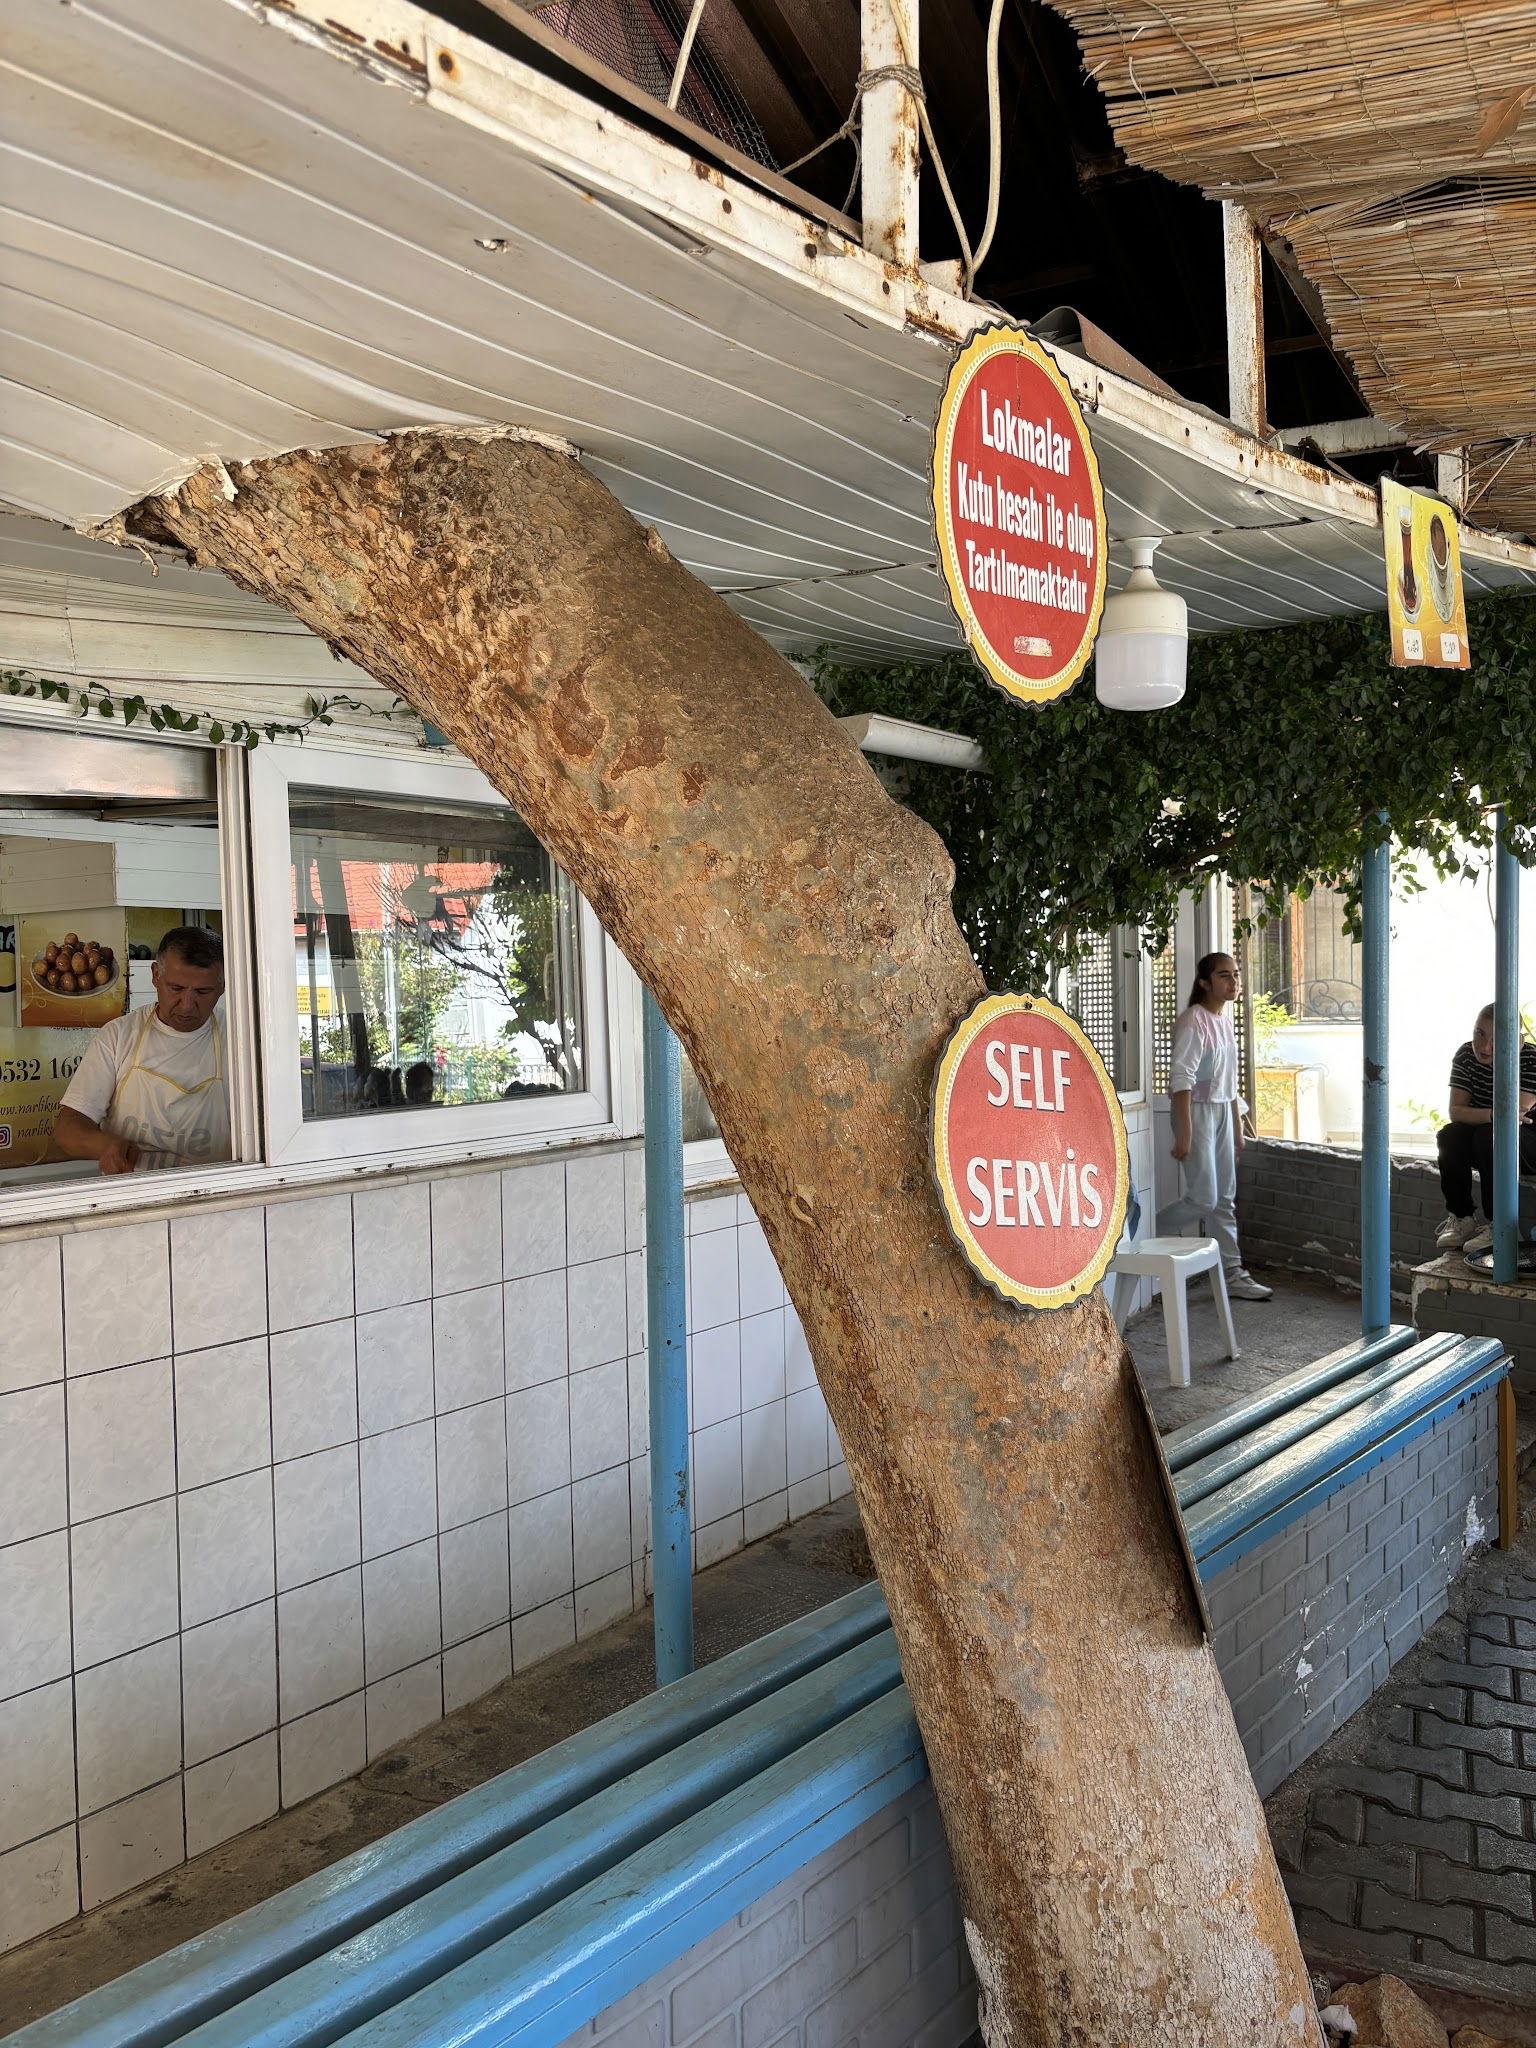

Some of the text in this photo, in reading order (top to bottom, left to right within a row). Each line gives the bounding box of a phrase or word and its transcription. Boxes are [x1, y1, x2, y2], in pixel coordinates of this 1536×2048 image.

[981, 390, 1071, 477] Lokmalar
[958, 461, 1094, 568] Kutu hesabı ile olup
[966, 539, 1087, 614] Tartılmamaktadır
[0, 1058, 41, 1083] 532
[985, 1040, 1071, 1112] SELF
[966, 1148, 1102, 1228] SERVİS
